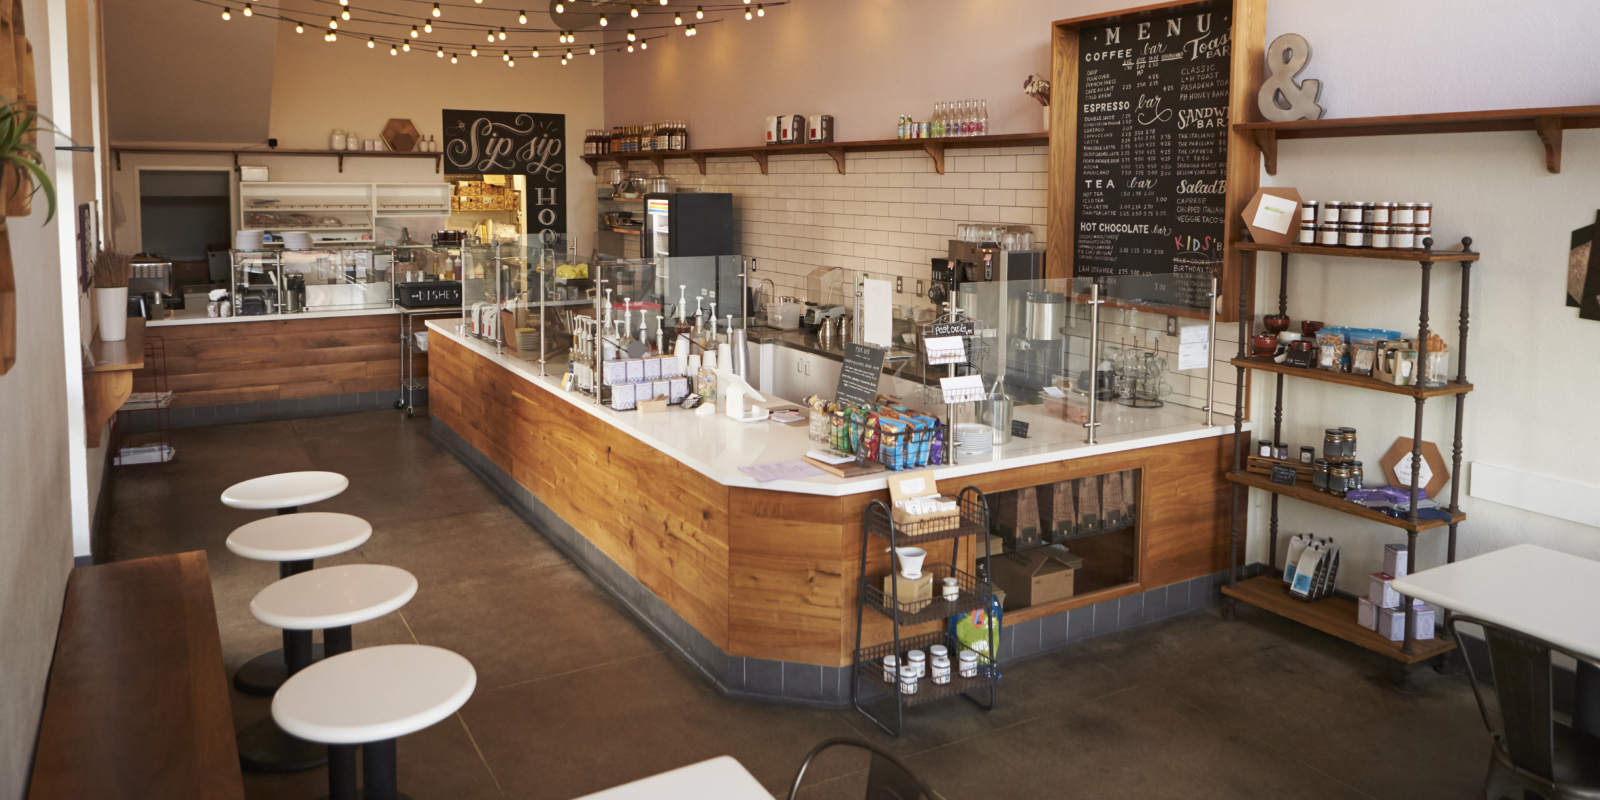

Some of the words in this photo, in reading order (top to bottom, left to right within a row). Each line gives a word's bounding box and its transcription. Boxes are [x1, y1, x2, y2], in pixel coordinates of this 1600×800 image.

[1105, 13, 1212, 46] MENU
[1085, 48, 1133, 62] COFFEE
[1141, 42, 1168, 56] bar
[1206, 45, 1231, 59] BAR
[1181, 64, 1216, 76] CLASSIC
[1196, 72, 1219, 81] TOAST
[1180, 80, 1214, 92] PASADENA
[1216, 79, 1229, 87] TOA
[1189, 91, 1211, 100] HONEY
[1211, 89, 1229, 98] BANA
[1083, 100, 1131, 114] ESPRESSO
[1196, 118, 1228, 129] BAR
[446, 114, 534, 172] Sip
[516, 132, 564, 182] sip
[1084, 179, 1115, 189] TEA
[1126, 176, 1158, 189] bar
[1176, 179, 1219, 194] Salad
[1217, 179, 1227, 194] B
[1176, 197, 1207, 205] CAPRESE
[1176, 214, 1201, 223] VEGGIE
[1202, 215, 1218, 224] TACO
[1080, 222, 1098, 233] HOT
[1098, 222, 1150, 235] CHOCOLATE
[1173, 264, 1204, 273] BIRTHDAY
[418, 289, 460, 301] DISHES
